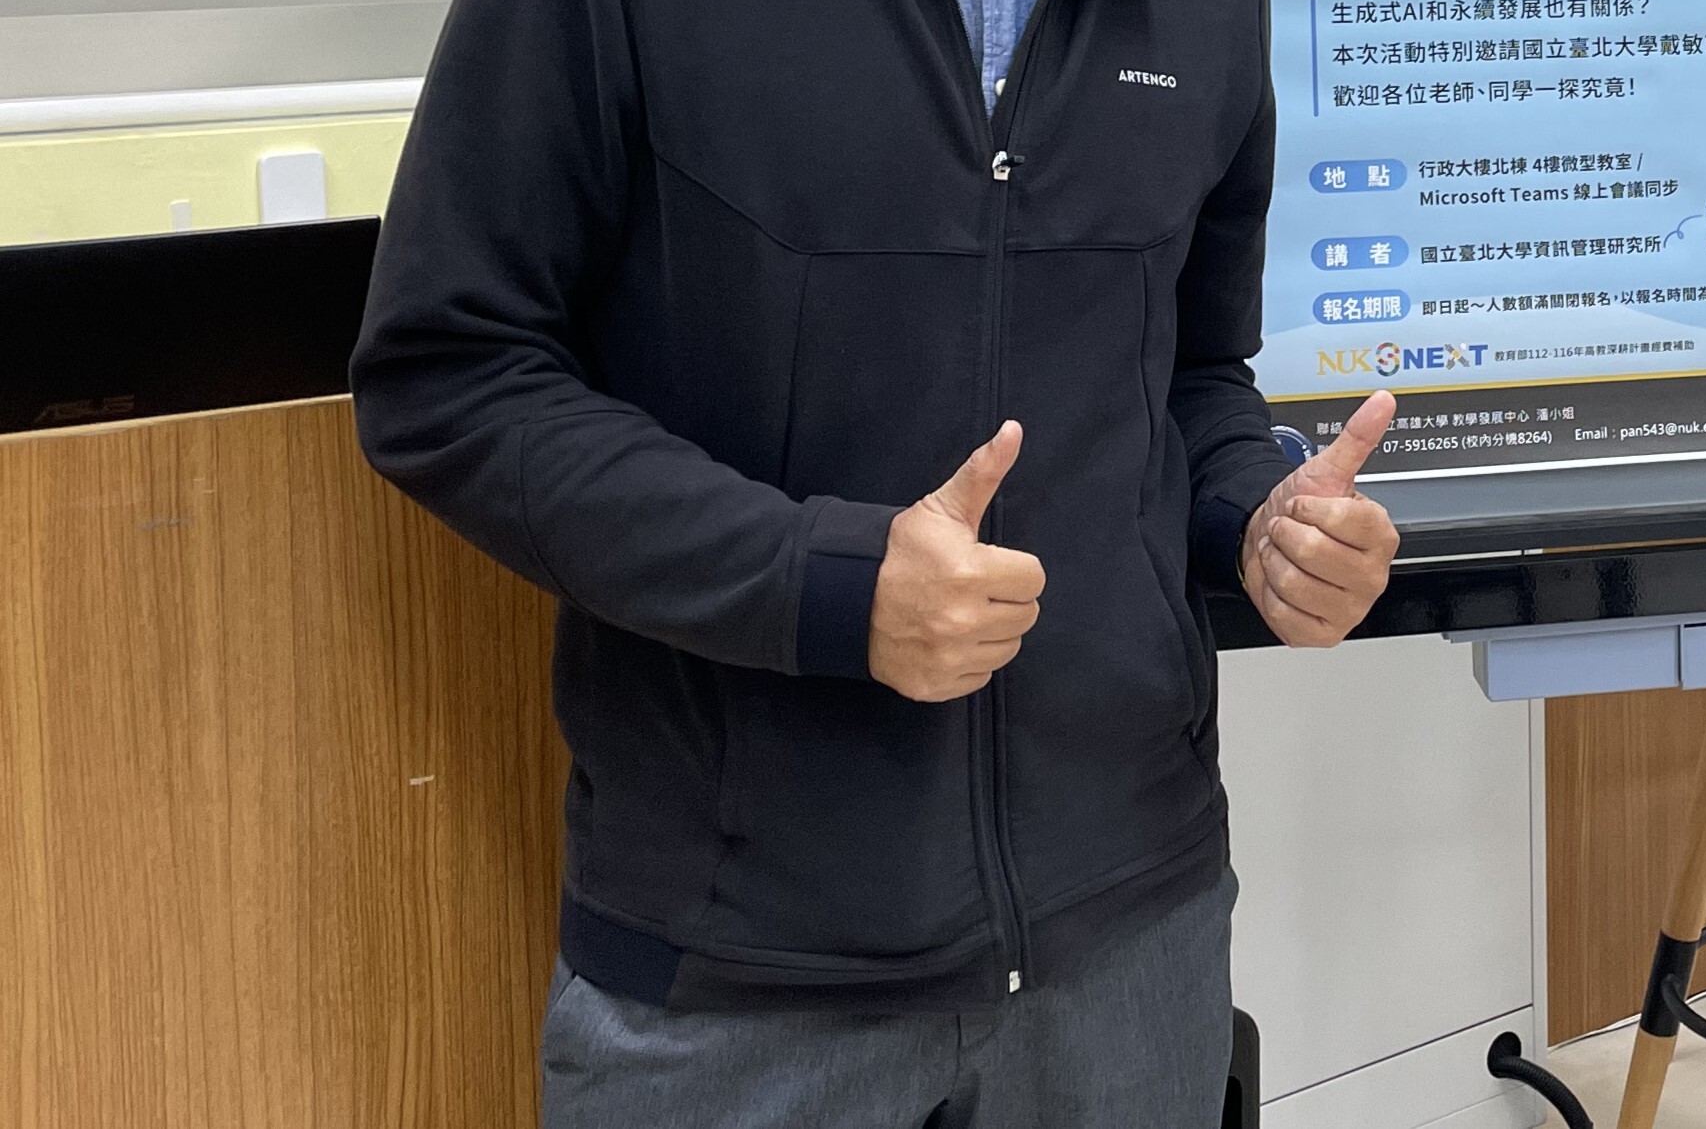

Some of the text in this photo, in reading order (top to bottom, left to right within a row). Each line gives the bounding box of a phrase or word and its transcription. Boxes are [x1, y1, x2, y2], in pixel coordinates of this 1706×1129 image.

[1118, 69, 1177, 88] ARTENGO
[1418, 156, 1527, 179] 行政大樓北棟
[1532, 152, 1632, 173] 4樓微型教室
[1419, 179, 1679, 206] Microsoft Teams 線上會議同步
[1420, 235, 1661, 264] 國立臺北大學資訊管理研究所
[1323, 296, 1402, 321] 報名期限
[1452, 409, 1530, 428] 教學發展中心
[1536, 407, 1575, 422] 潘小姐
